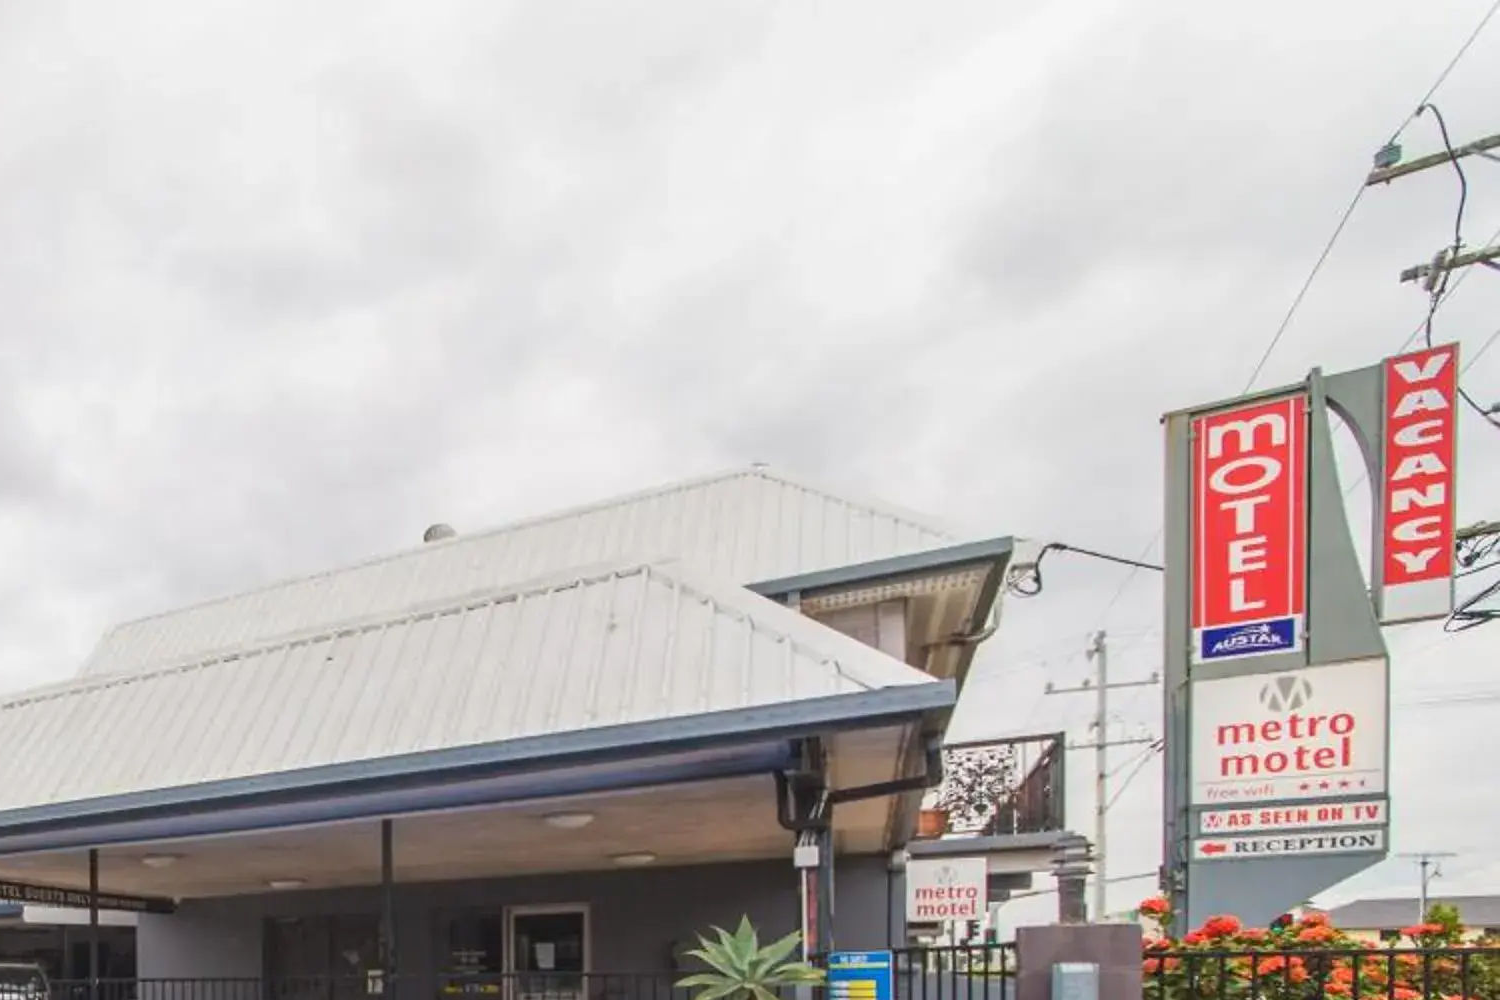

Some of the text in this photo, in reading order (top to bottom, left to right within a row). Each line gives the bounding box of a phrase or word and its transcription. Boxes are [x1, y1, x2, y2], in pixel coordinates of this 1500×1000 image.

[1391, 352, 1450, 575] VACANCY
[1217, 713, 1355, 745] metro
[1220, 736, 1350, 777] motel
[1206, 786, 1239, 799] free
[1227, 804, 1380, 827] AS SEEN ON TV
[1234, 834, 1377, 853] RECEPTION
[915, 886, 978, 899] metro
[916, 897, 975, 917] motel
